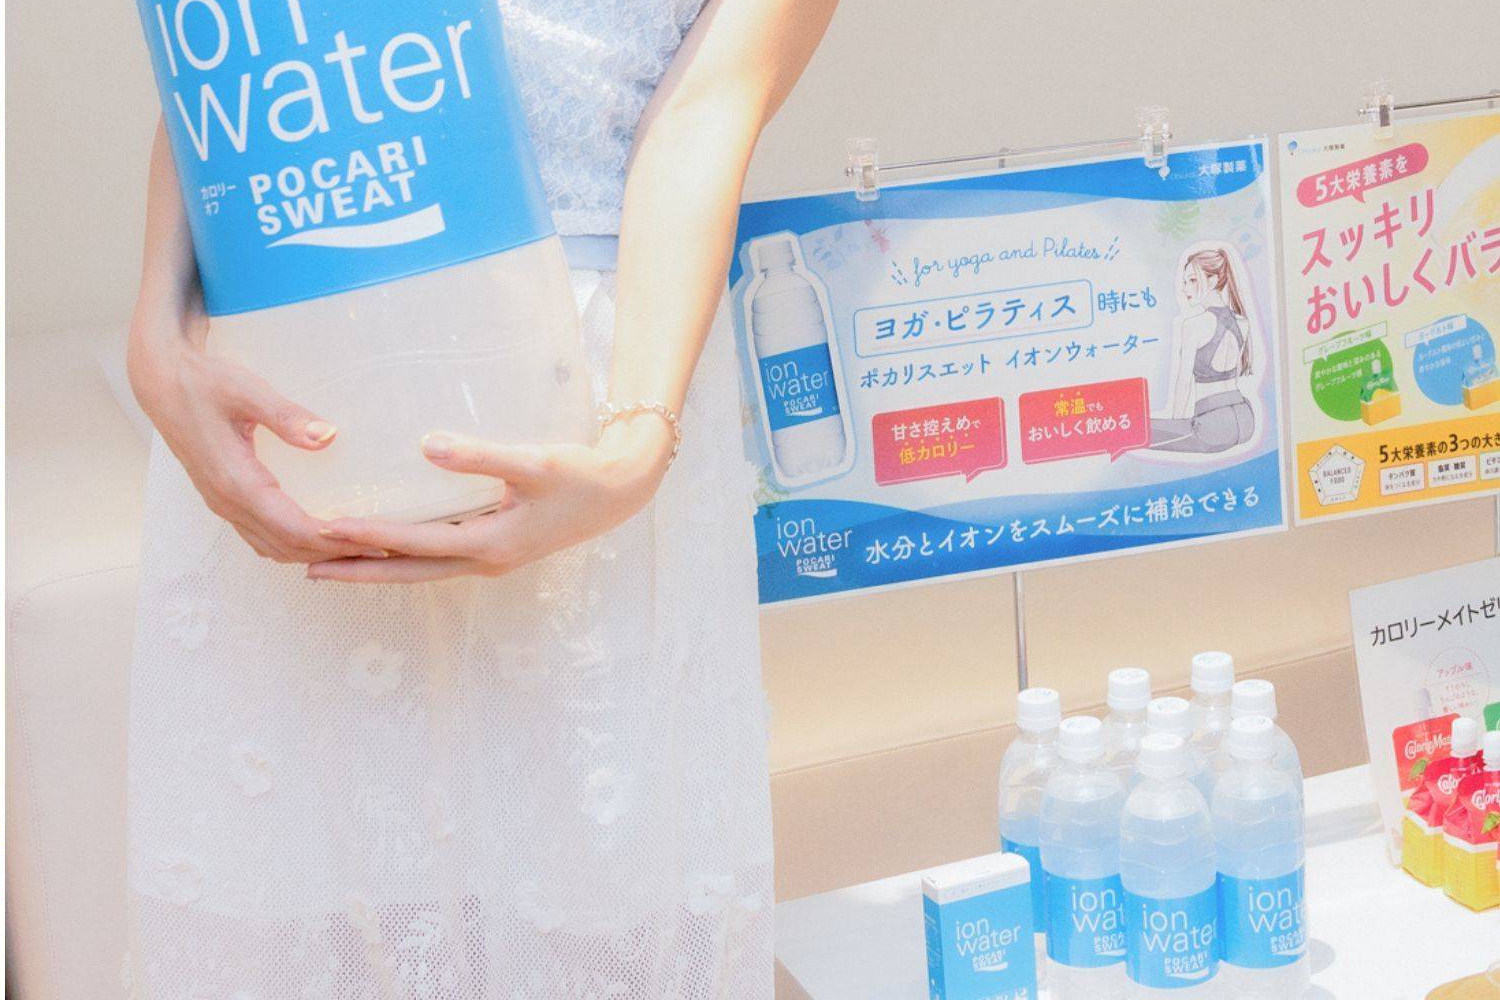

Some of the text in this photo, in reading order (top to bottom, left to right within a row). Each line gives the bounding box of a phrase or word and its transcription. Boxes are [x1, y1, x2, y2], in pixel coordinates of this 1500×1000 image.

[173, 20, 472, 162] water
[249, 136, 428, 205] POCARI
[1315, 154, 1408, 201] 5大栄養素を
[200, 183, 236, 200] カロリー
[257, 171, 416, 236] SWEAT
[205, 202, 220, 217] オフ
[1301, 189, 1433, 276] スッキリ
[913, 235, 1100, 288] for yoga and Pilates
[875, 287, 1157, 341] ヨガ・ピラティス 時にも
[764, 361, 798, 383] ion
[860, 334, 1160, 389] ポカリスエット イオンウォーター
[768, 370, 828, 400] water
[1054, 397, 1104, 417] 常温でも
[891, 414, 981, 442] 甘さ控えめで
[1028, 414, 1132, 443] おいしく飲める
[899, 441, 975, 466] 低カロリー
[776, 516, 815, 539] ion
[866, 486, 1260, 565] 水分とイオンをスムーズに補給できる
[777, 528, 853, 559] water
[795, 554, 835, 567] POCARI
[796, 562, 832, 574] SWEAT
[1071, 886, 1116, 912] ion
[1248, 886, 1292, 912] ion
[956, 919, 989, 941] ion
[1142, 904, 1188, 932] ion
[956, 925, 1021, 957] water
[1143, 918, 1217, 953] water
